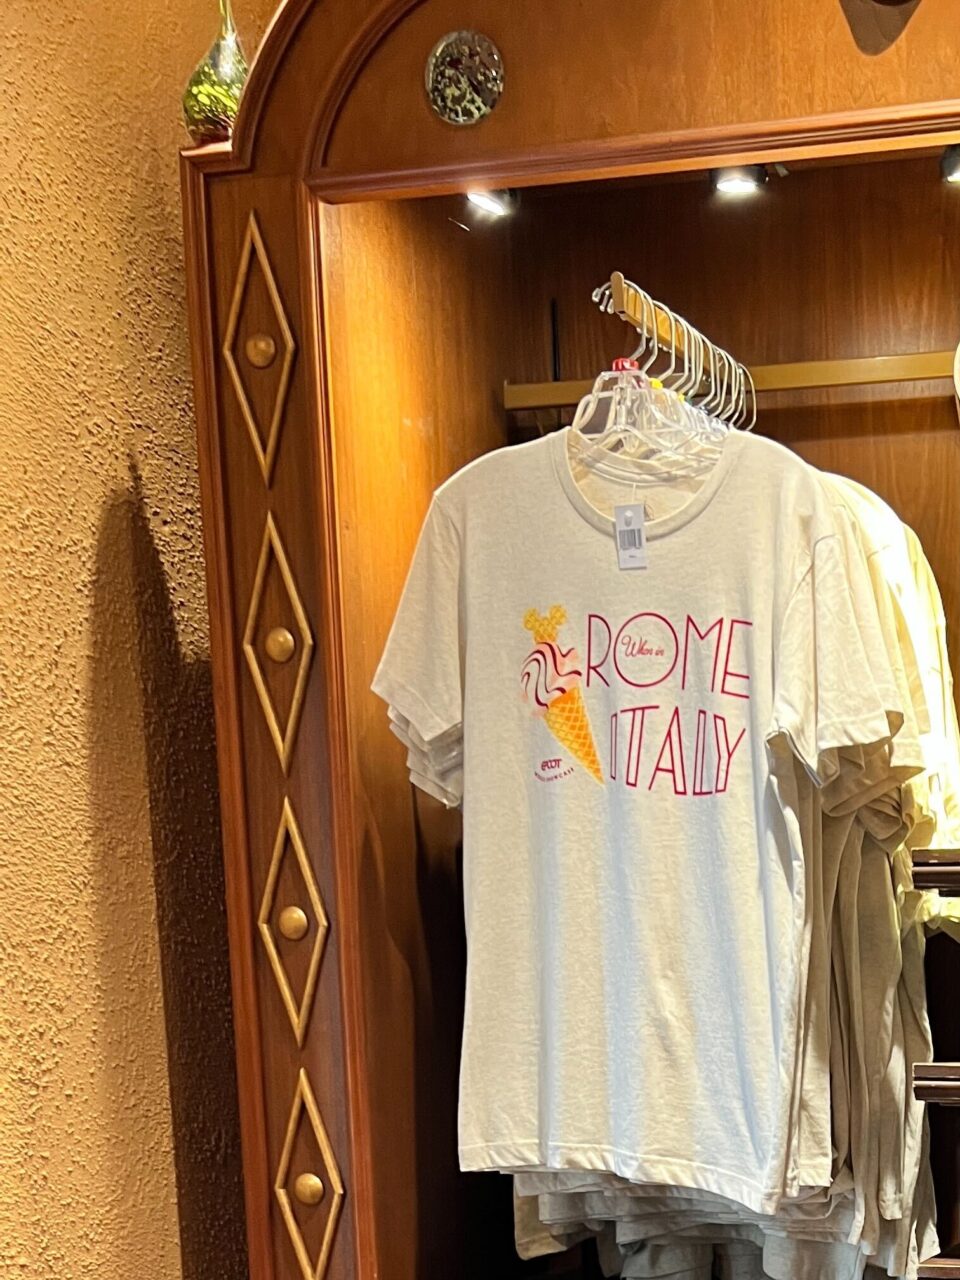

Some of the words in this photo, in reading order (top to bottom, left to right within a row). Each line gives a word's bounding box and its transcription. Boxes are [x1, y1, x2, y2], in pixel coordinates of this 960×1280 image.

[586, 612, 753, 699] ROME
[621, 634, 653, 658] When
[610, 705, 746, 796] ITALY
